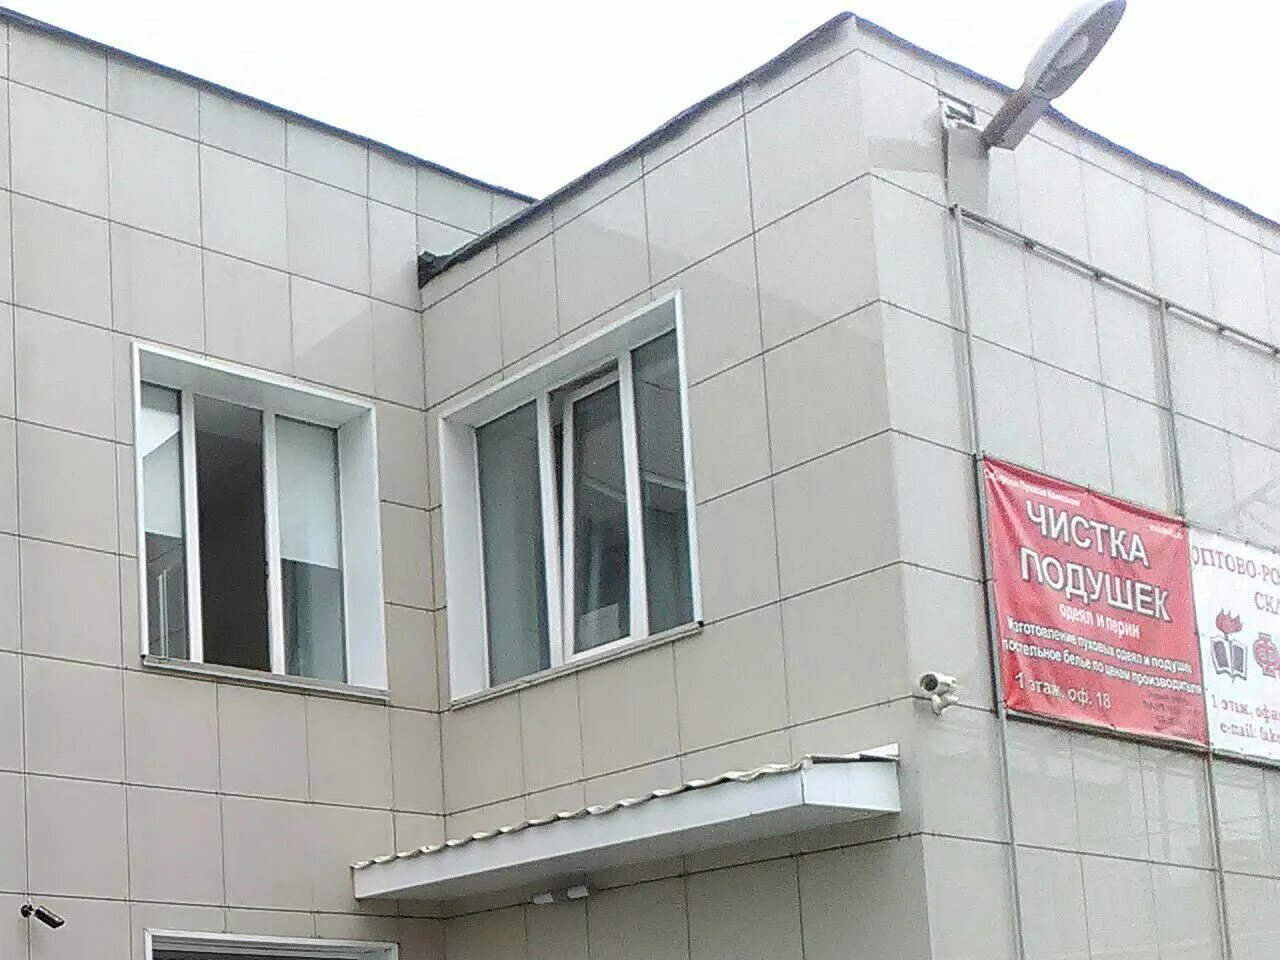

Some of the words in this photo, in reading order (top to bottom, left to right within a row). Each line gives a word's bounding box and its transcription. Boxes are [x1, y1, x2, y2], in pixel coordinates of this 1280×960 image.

[1025, 500, 1150, 569] ЧИСТКА
[1021, 547, 1170, 620] ПОДУШЕК
[1007, 616, 1077, 645] Изготовление
[1077, 636, 1115, 657] пуховых
[1115, 648, 1143, 664] одеял
[1143, 656, 1150, 666] и
[1060, 603, 1095, 626] одеял
[1096, 612, 1105, 629] и
[1106, 616, 1140, 638] перин
[1002, 639, 1062, 661] постельное
[1063, 649, 1092, 669] белье
[1015, 671, 1024, 689] 1
[1067, 686, 1093, 707] оф.
[1095, 691, 1112, 710] 18
